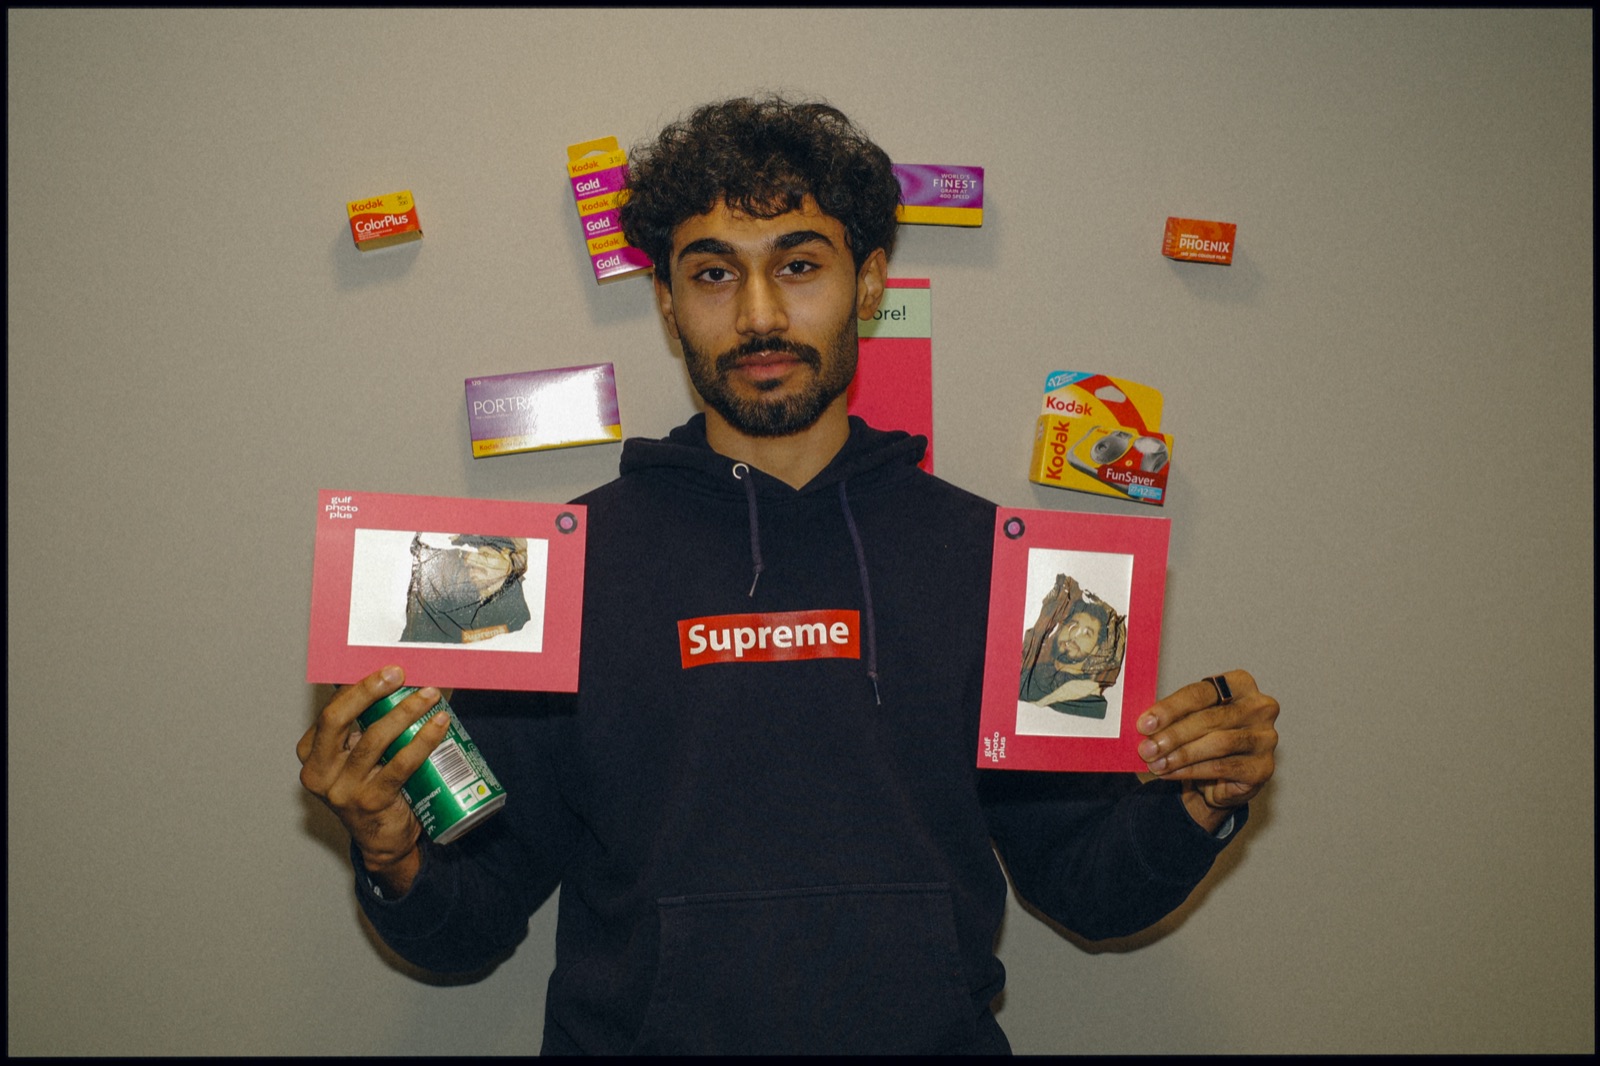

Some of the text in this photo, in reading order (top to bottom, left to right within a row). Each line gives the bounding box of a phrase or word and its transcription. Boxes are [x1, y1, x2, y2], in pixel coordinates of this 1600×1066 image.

[571, 161, 600, 173] Kodak
[576, 178, 601, 193] Gold
[933, 179, 977, 189] FINEST
[351, 199, 384, 213] Kodak
[581, 199, 609, 212] Kodak
[355, 214, 409, 233] ColorPlus
[586, 217, 611, 232] Gold
[592, 238, 620, 251] Kodak
[1179, 238, 1230, 253] PHOENIX
[596, 255, 621, 270] Gold
[872, 305, 907, 320] ore!
[1046, 396, 1093, 416] Kodak
[479, 442, 499, 451] Kodak
[1046, 420, 1070, 480] Kodak
[1106, 468, 1155, 486] FunSaver
[331, 496, 352, 504] gulf
[325, 504, 358, 512] photo
[330, 511, 352, 519] plus
[688, 621, 849, 658] Supreme
[998, 736, 1006, 758] plus
